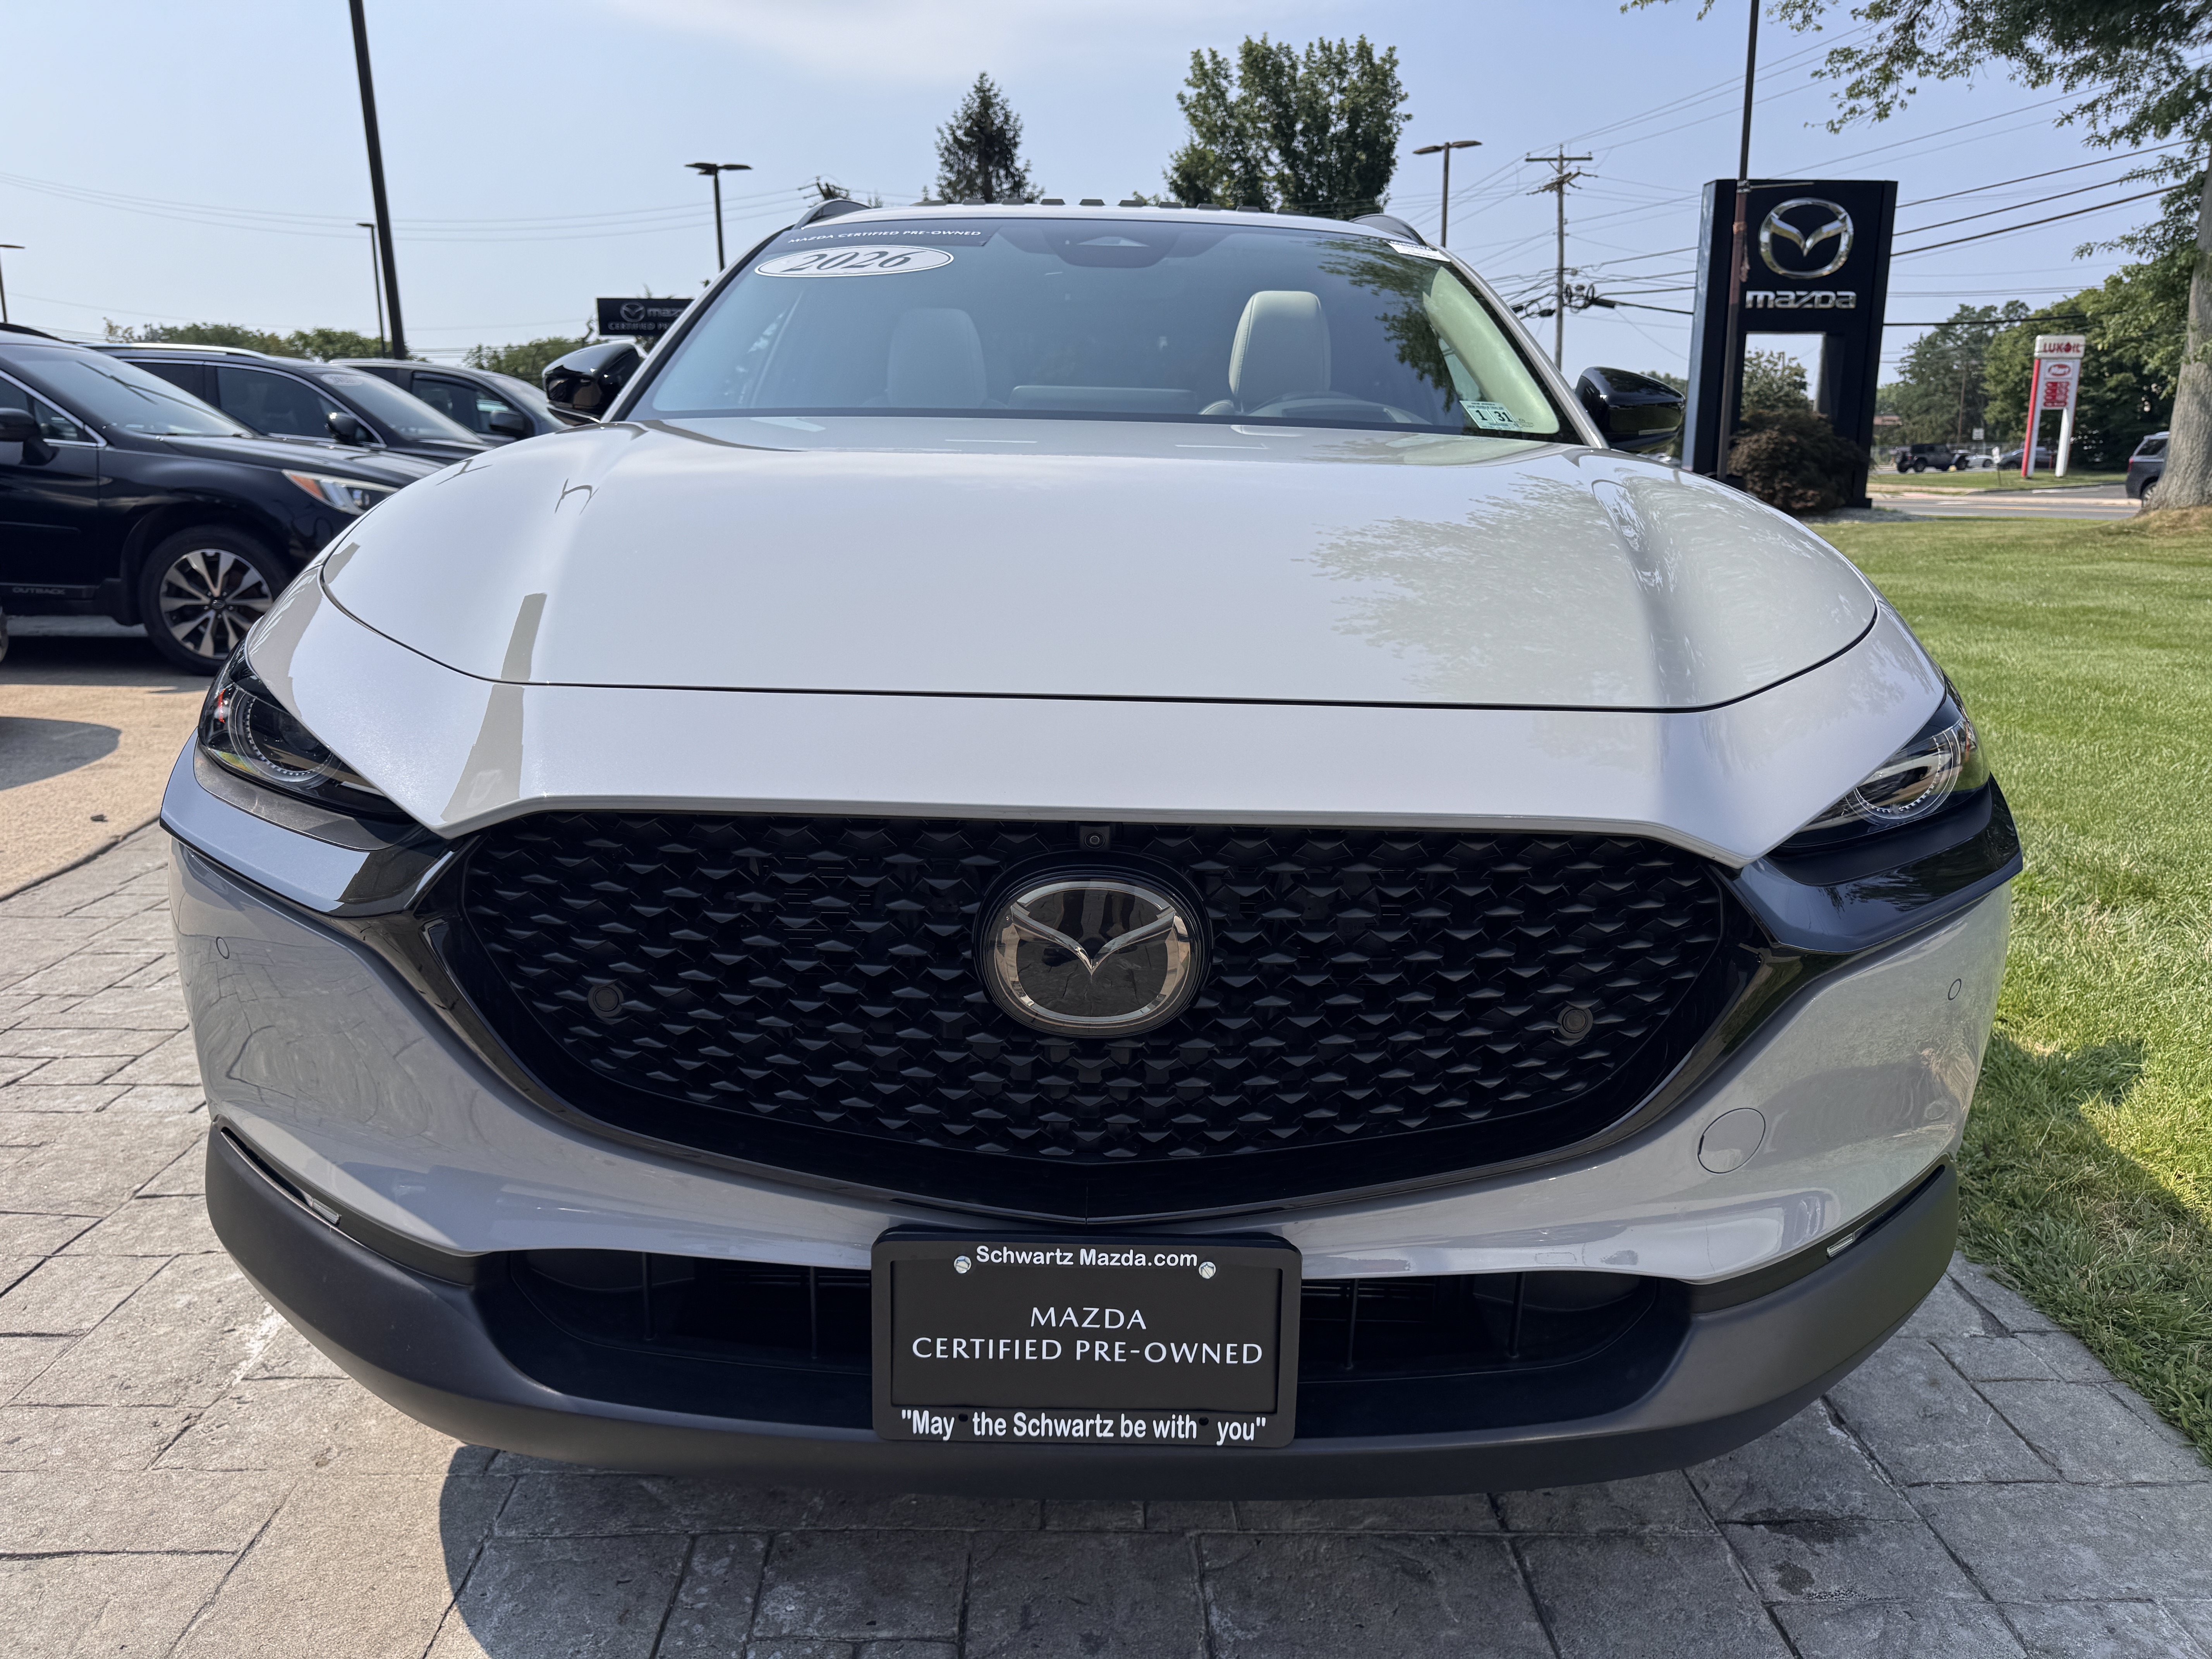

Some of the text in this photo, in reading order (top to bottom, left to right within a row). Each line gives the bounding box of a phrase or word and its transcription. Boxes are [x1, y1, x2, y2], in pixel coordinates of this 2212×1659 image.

[788, 234, 833, 243] MAZDA
[779, 251, 927, 273] 2026
[1745, 290, 1856, 308] mazda
[647, 307, 685, 318] maz
[2044, 342, 2081, 353] LUKOIL
[1476, 410, 1513, 422] 1 31
[976, 1245, 1197, 1267] Schwartz Mazda.com
[1031, 1307, 1146, 1329] MAZDA
[912, 1337, 1262, 1364] CERTIFIED PRE-OWNED
[902, 1410, 1266, 1446] "May the Schwartz be with you"
